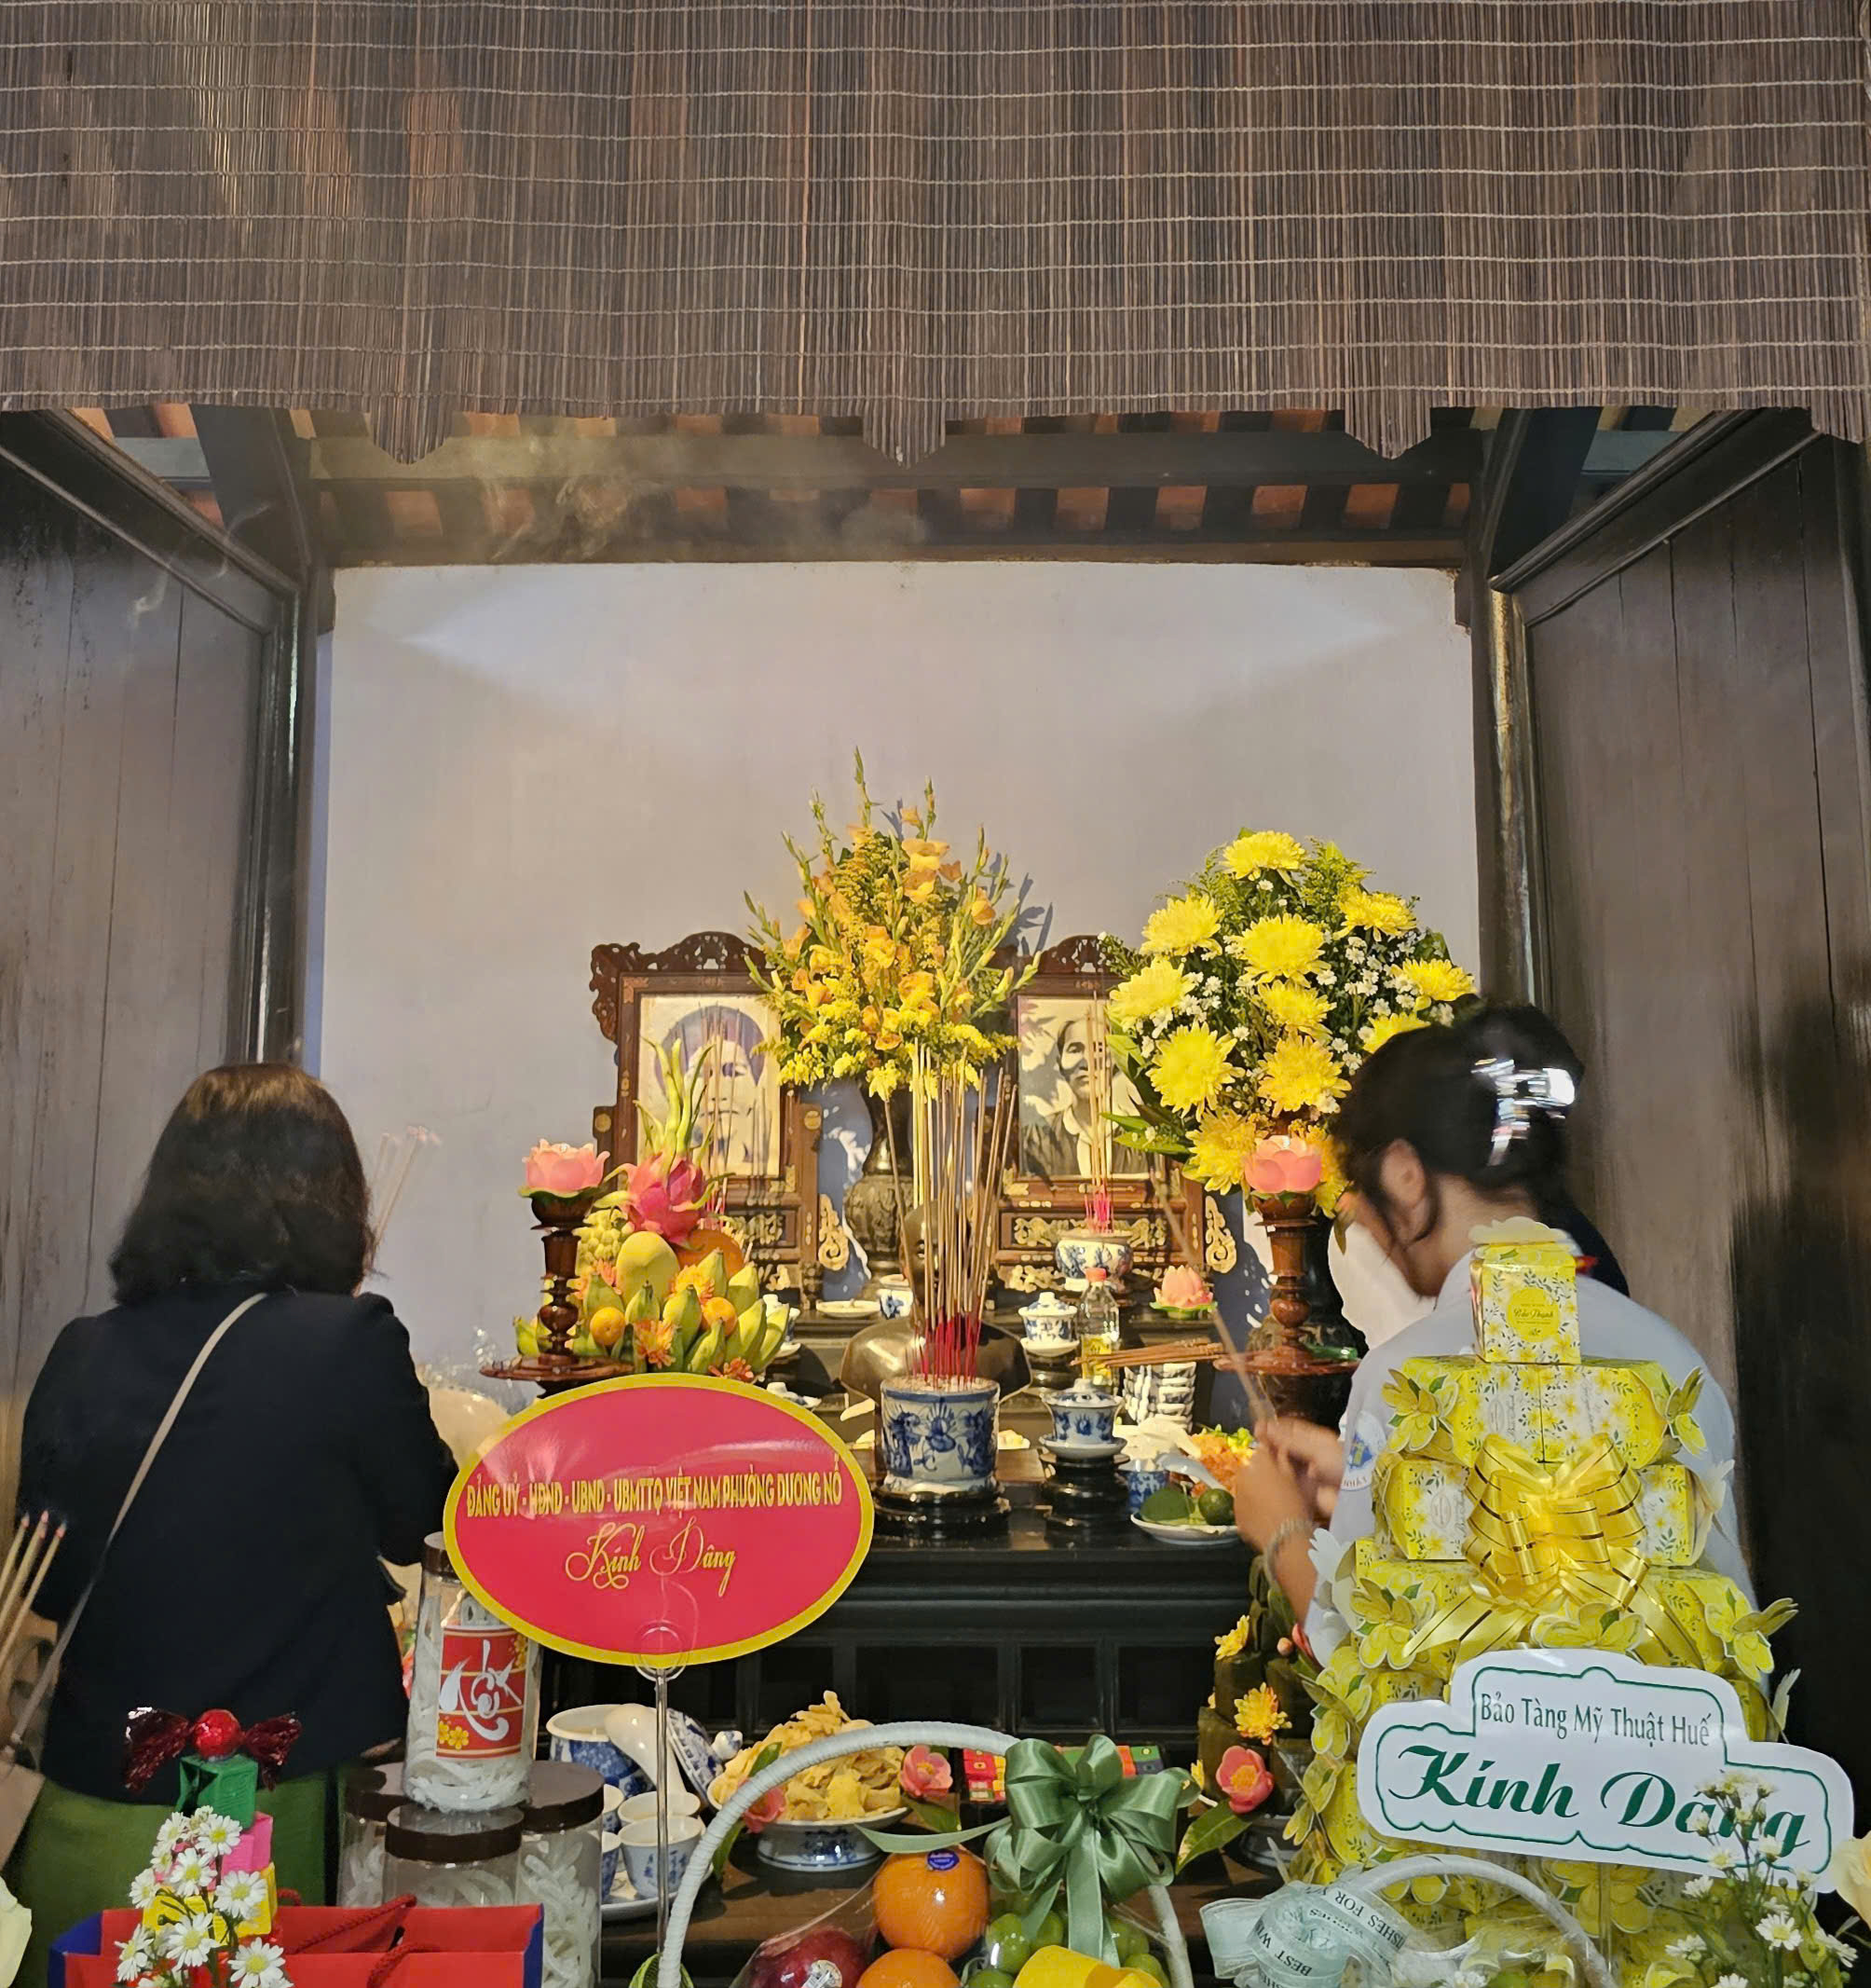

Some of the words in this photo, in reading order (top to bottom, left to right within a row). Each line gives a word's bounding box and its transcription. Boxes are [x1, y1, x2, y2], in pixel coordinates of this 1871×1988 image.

[467, 1474, 500, 1517] ĐẢNG
[529, 1480, 563, 1515] HĐND
[571, 1478, 606, 1514] UBND
[613, 1477, 662, 1515] UBMTTQ
[665, 1465, 691, 1518] VIỆT
[693, 1475, 720, 1508] NAM
[565, 1522, 646, 1589] Kính
[649, 1515, 736, 1597] Dâng
[1482, 1691, 1515, 1724] Bảo
[1521, 1697, 1567, 1740] Tàng
[1574, 1704, 1604, 1743] Mỹ
[1610, 1707, 1664, 1748] Thuật
[1672, 1712, 1712, 1747] Huế
[1387, 1745, 1579, 1818] Kính
[1334, 1890, 1364, 1918] FOR
[1275, 1950, 1312, 1977] BEST
